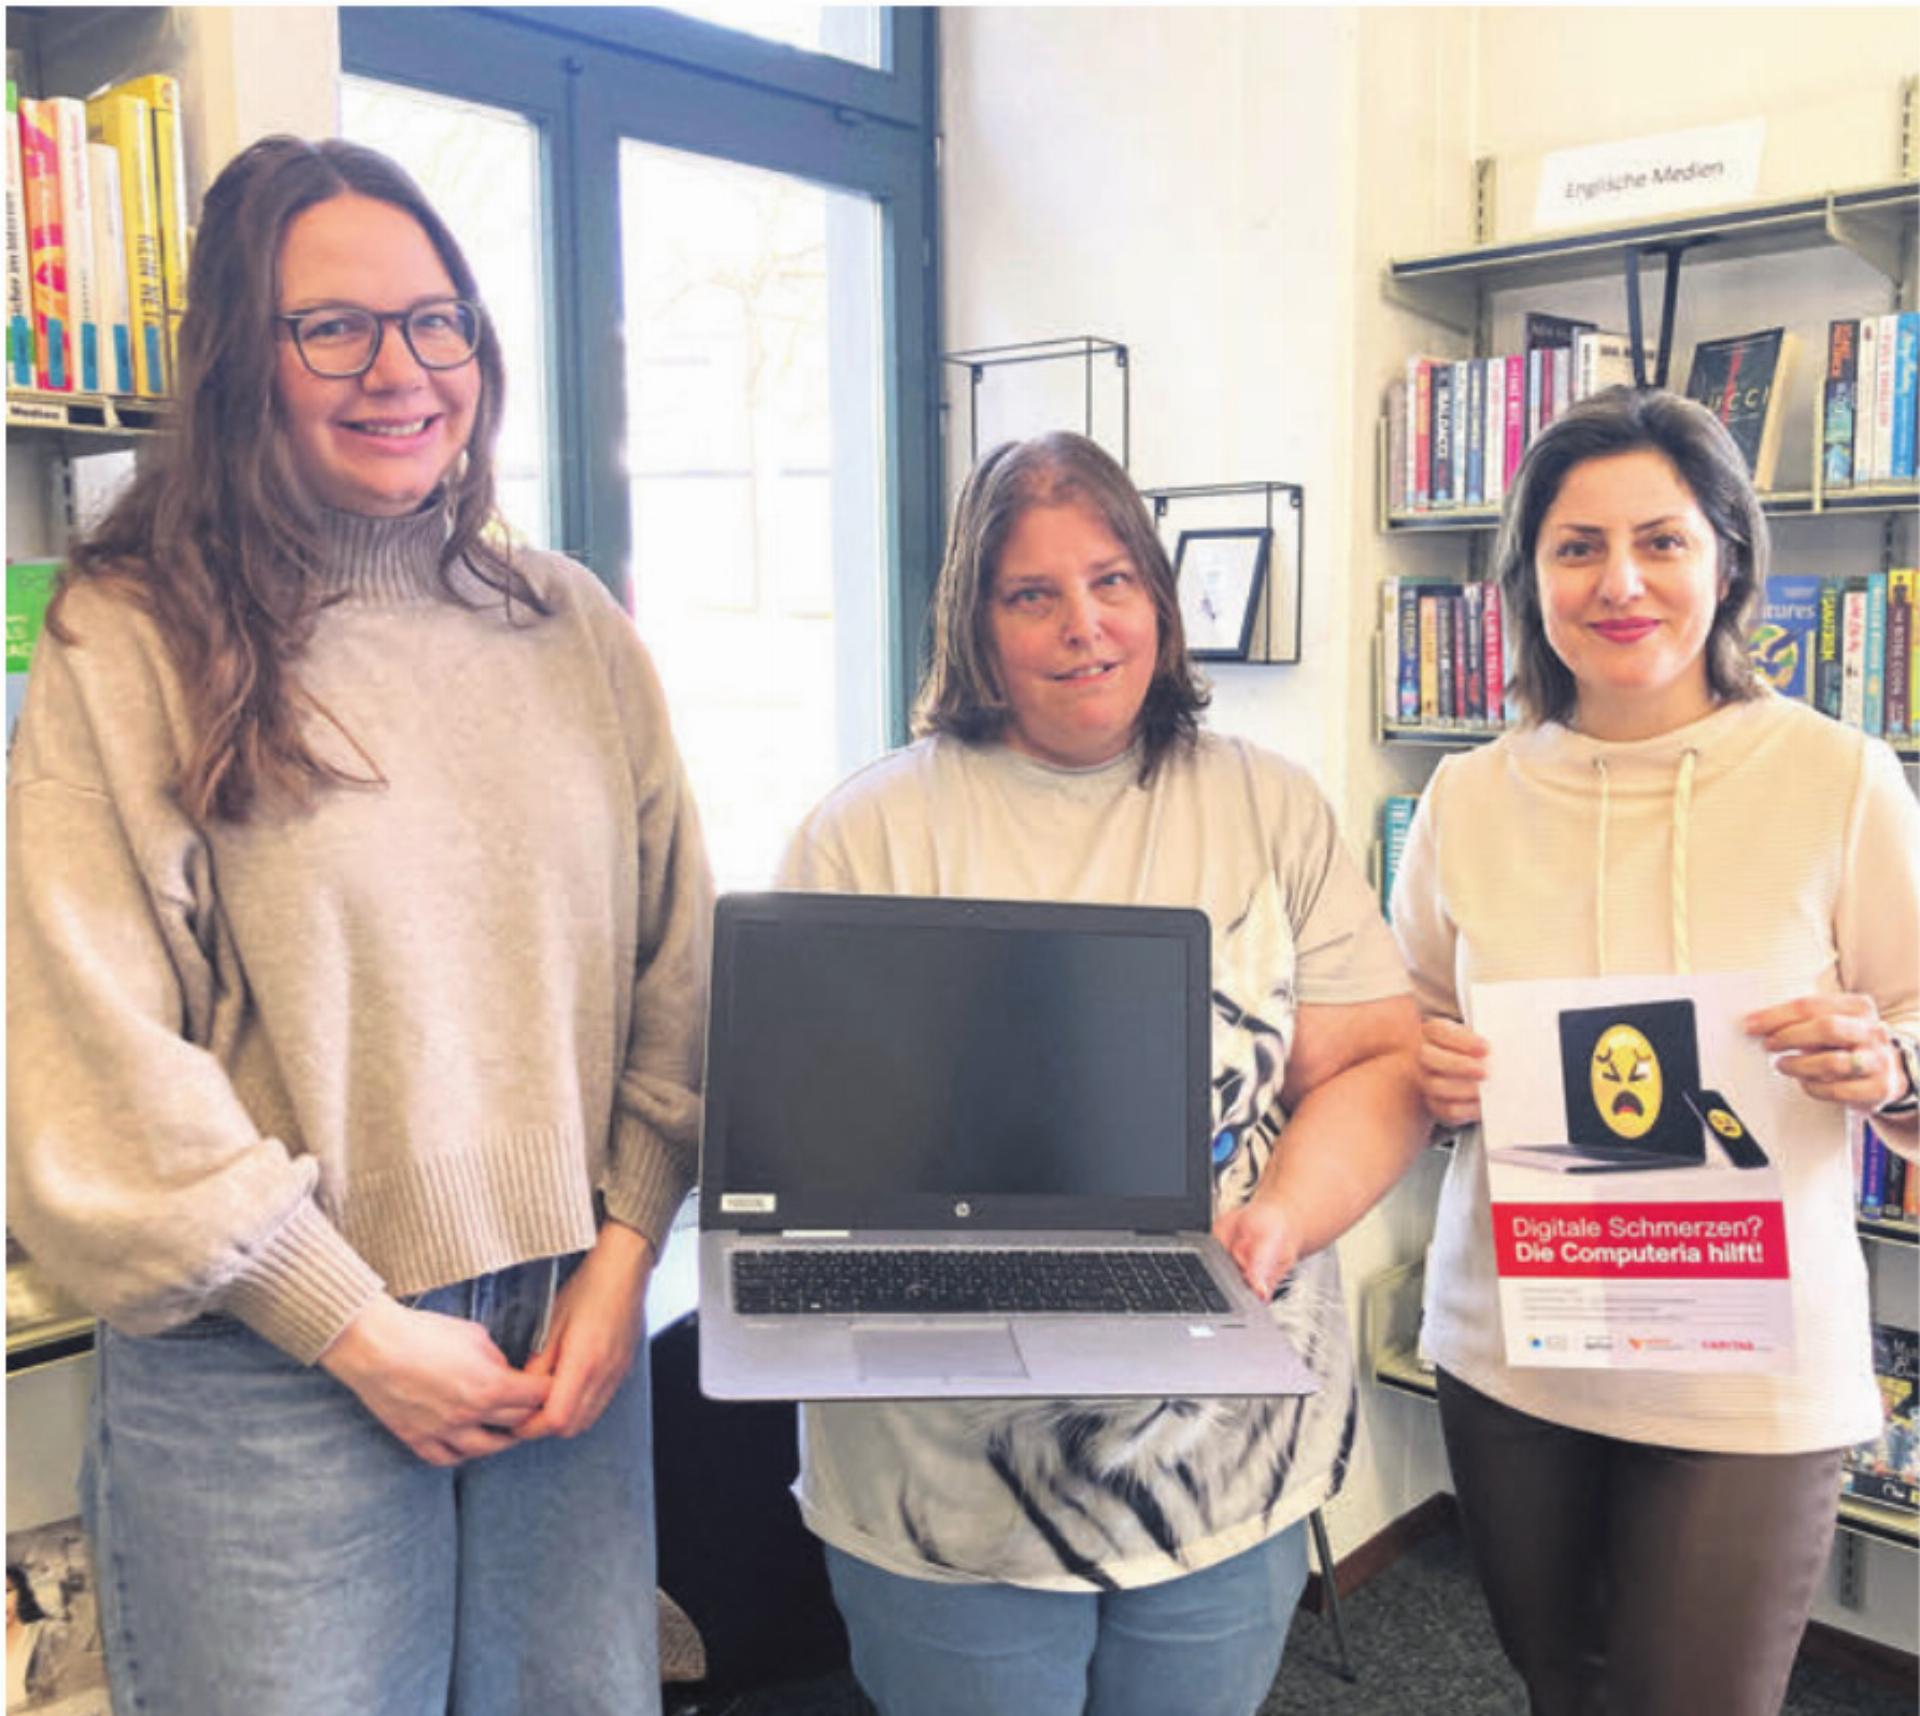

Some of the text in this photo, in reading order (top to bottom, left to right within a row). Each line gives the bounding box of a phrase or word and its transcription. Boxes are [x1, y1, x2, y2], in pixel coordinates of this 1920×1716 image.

[1565, 160, 1725, 200] Englische Medien
[1513, 1215, 1764, 1241] Digitale Schmerzen?
[1515, 1242, 1764, 1268] Die Computeria hilft!
